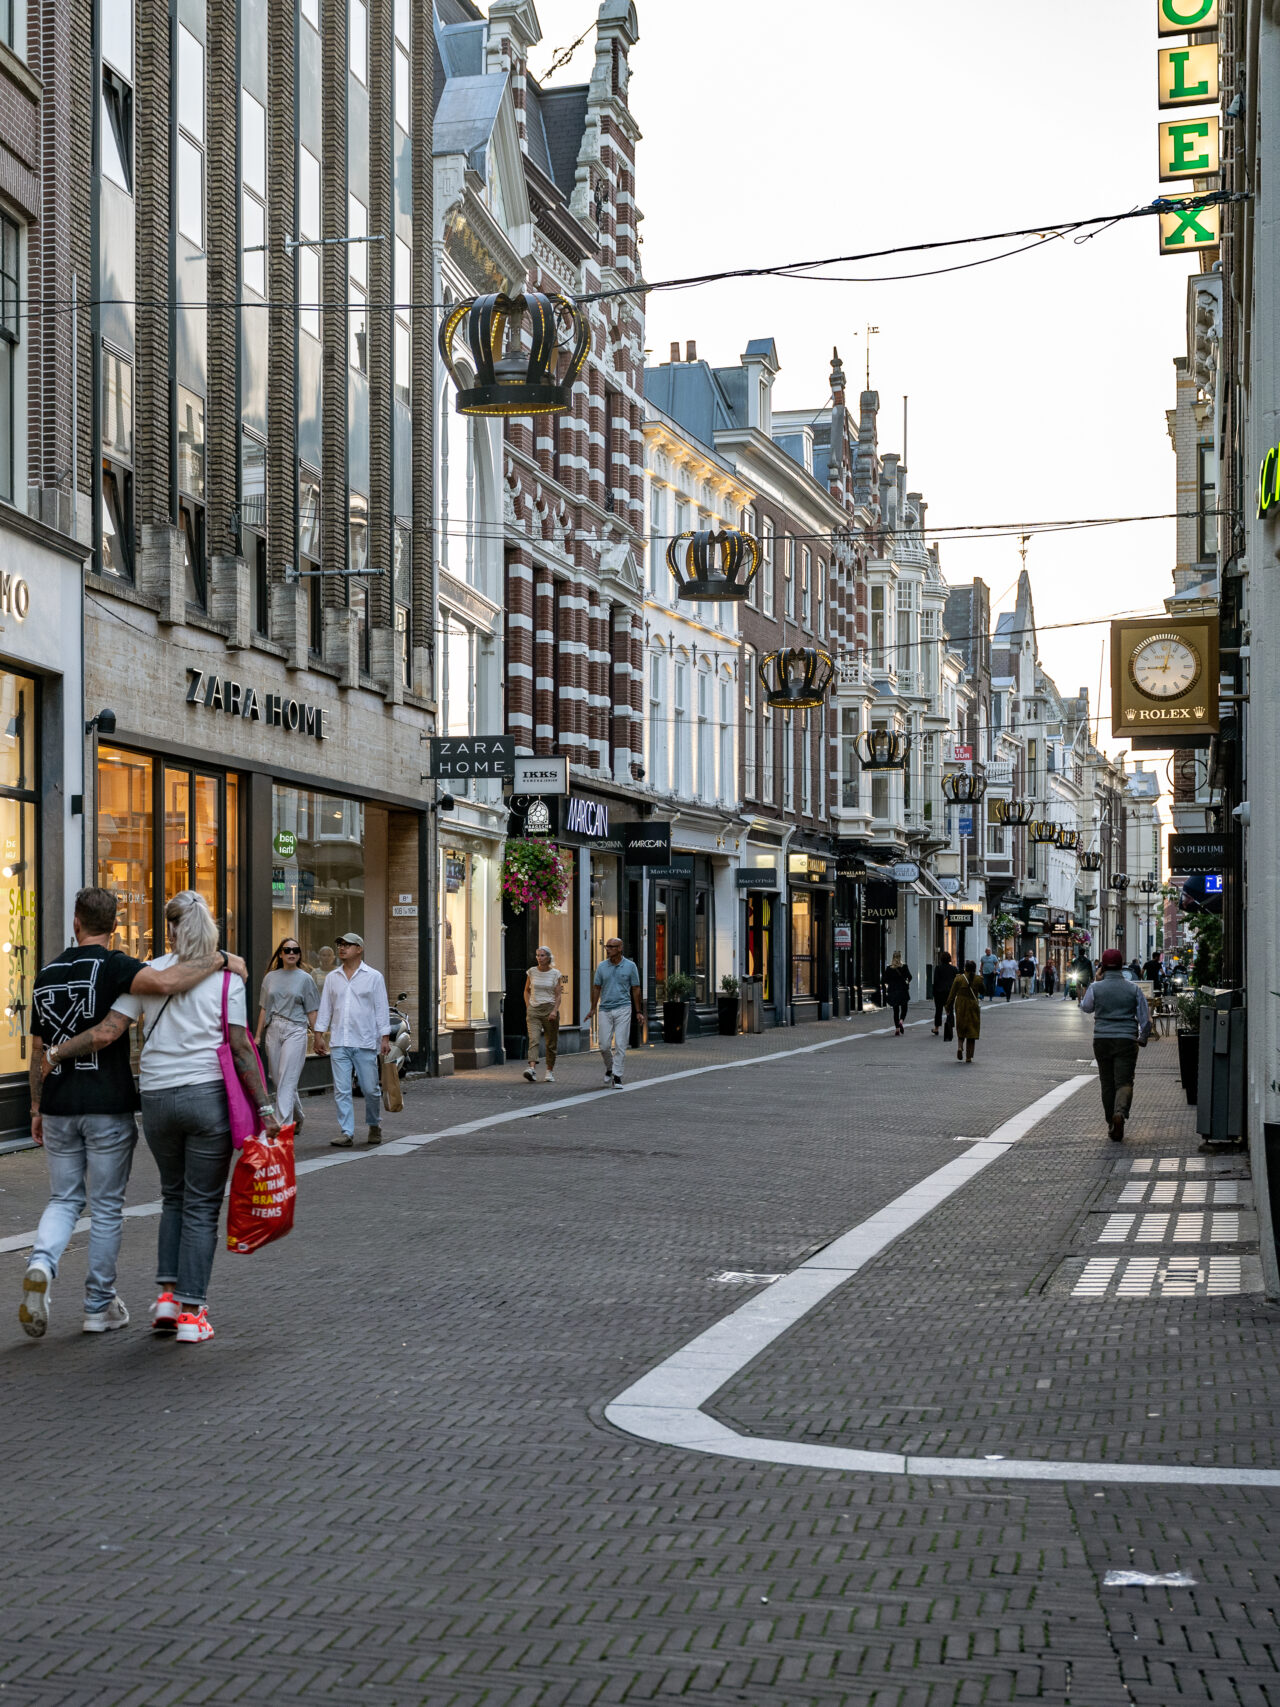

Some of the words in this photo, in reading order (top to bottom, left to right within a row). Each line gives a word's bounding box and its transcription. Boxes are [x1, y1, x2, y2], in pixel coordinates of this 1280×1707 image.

[186, 667, 260, 721] ZARA
[266, 694, 329, 739] HOME
[1139, 708, 1191, 720] ROLEX
[440, 742, 505, 755] ZARA
[440, 761, 505, 773] HOME
[9, 888, 36, 917] SALE
[867, 908, 897, 917] PAUW
[9, 917, 36, 946] SALE
[251, 1207, 282, 1217] ITEMS
